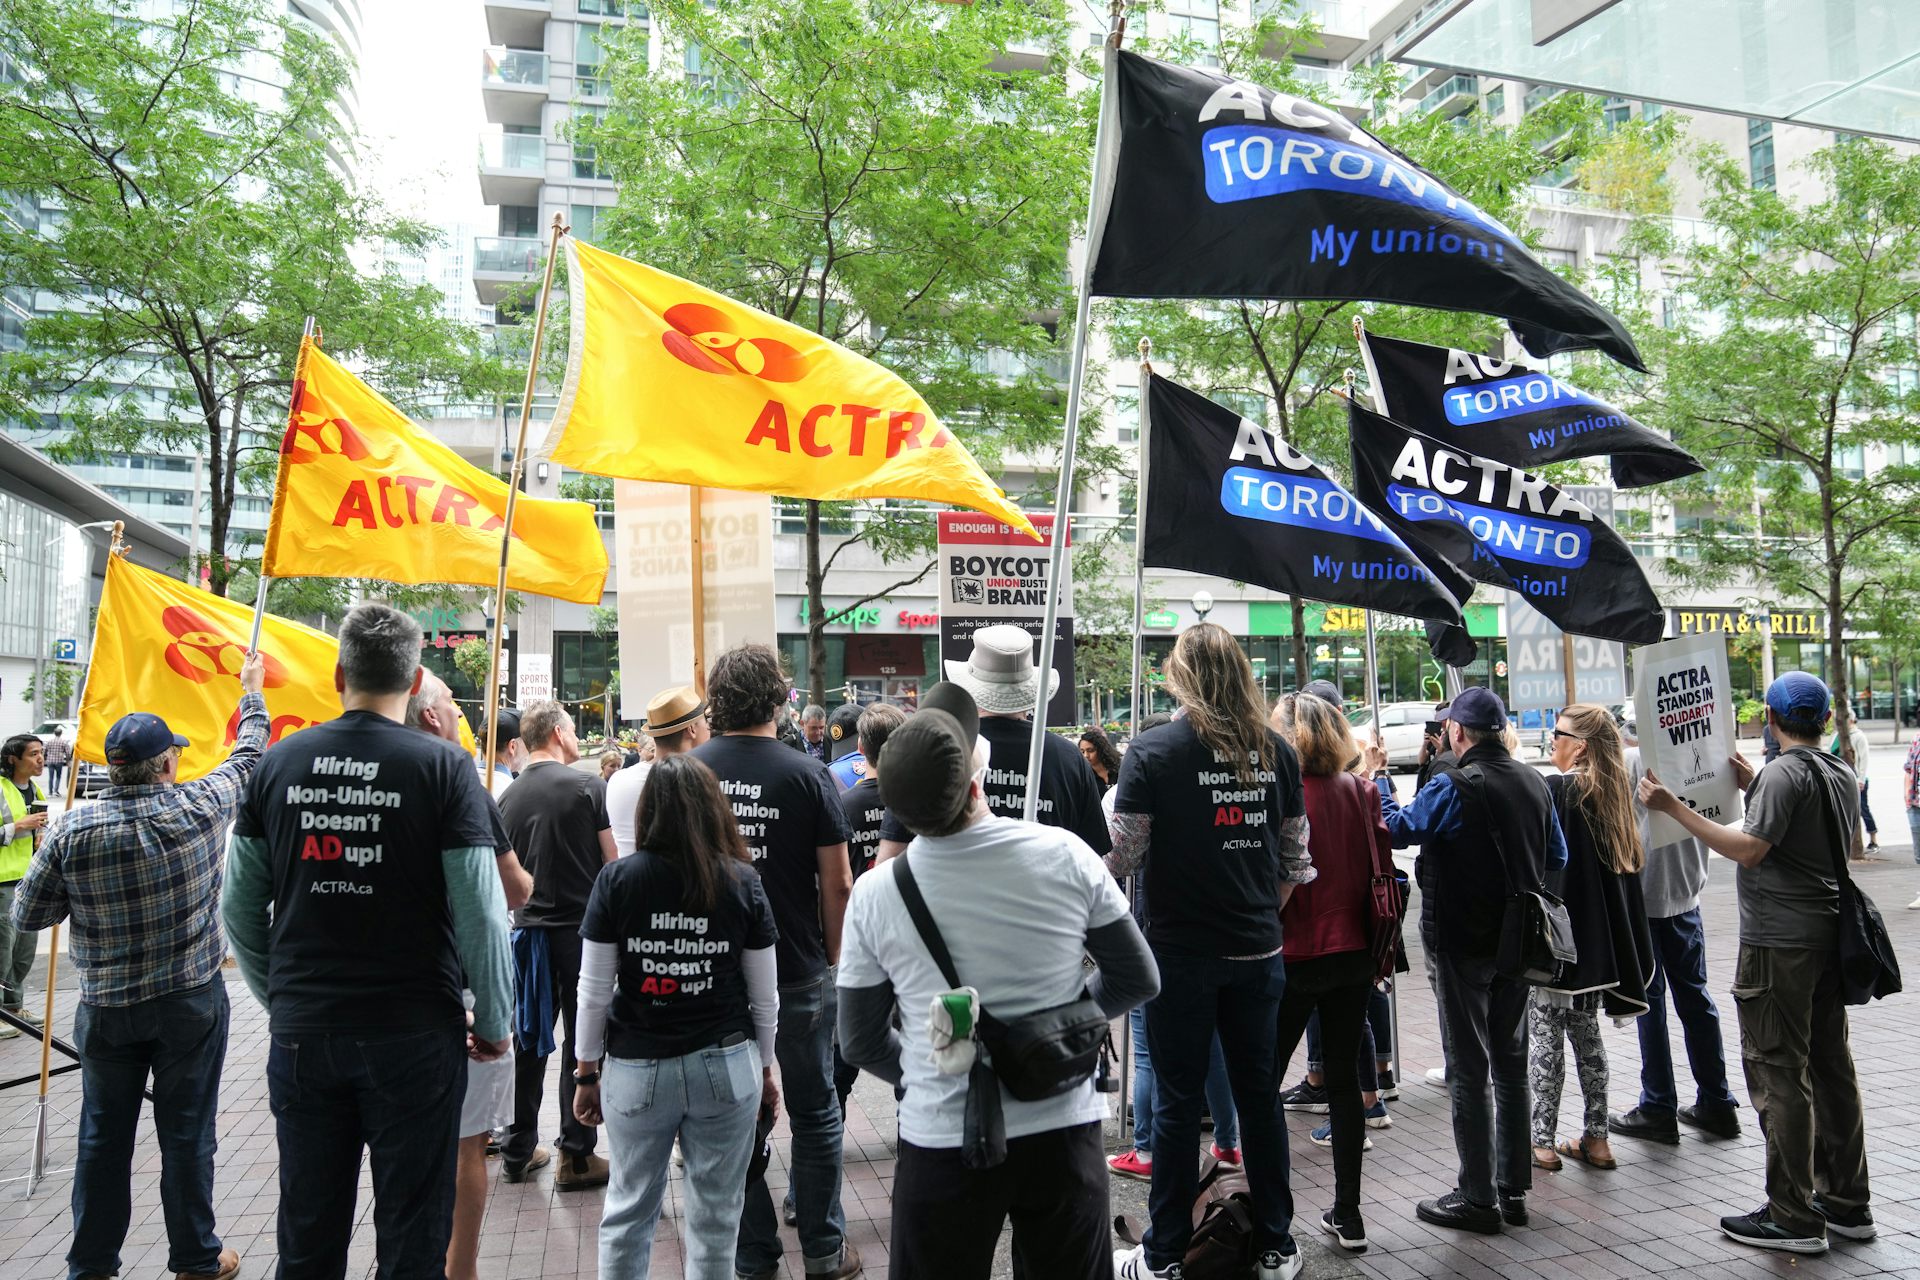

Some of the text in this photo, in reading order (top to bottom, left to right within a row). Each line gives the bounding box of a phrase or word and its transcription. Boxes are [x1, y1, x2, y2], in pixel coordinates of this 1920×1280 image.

[1210, 145, 1475, 212] TORON
[1310, 224, 1504, 266] My union!
[1528, 413, 1628, 449] My union!
[1391, 437, 1594, 521] ACTRA
[949, 523, 996, 533] ENOUGH
[1000, 524, 1010, 534] IS
[950, 556, 1050, 577] BOYCOT
[1313, 555, 1344, 583] My
[975, 620, 989, 628] lock
[952, 632, 967, 640] and
[61, 641, 74, 657] P
[520, 674, 549, 684] SPORTS
[879, 666, 897, 674] 125
[520, 687, 547, 696] ACTION
[1657, 665, 1711, 697] ACTRA
[1657, 686, 1714, 714] STANDS IN
[1660, 702, 1715, 728] SOLIDARITY
[1668, 717, 1712, 746] WITH
[312, 756, 380, 781] Hiring
[986, 769, 1028, 788] Hirin
[286, 785, 401, 808] Non-Union
[1212, 788, 1267, 804] Doesn't
[301, 811, 382, 832] Doesn't
[1214, 806, 1267, 827] AD up!
[1697, 805, 1721, 819] TRA
[301, 835, 382, 867] AD up!
[1222, 840, 1262, 850] ACTRA.ca
[310, 881, 373, 895] ACTRA.ca
[651, 912, 708, 934] Hiring
[627, 937, 730, 955] Non-Union
[642, 958, 712, 976] Doesn't
[641, 976, 713, 995] AD up!
